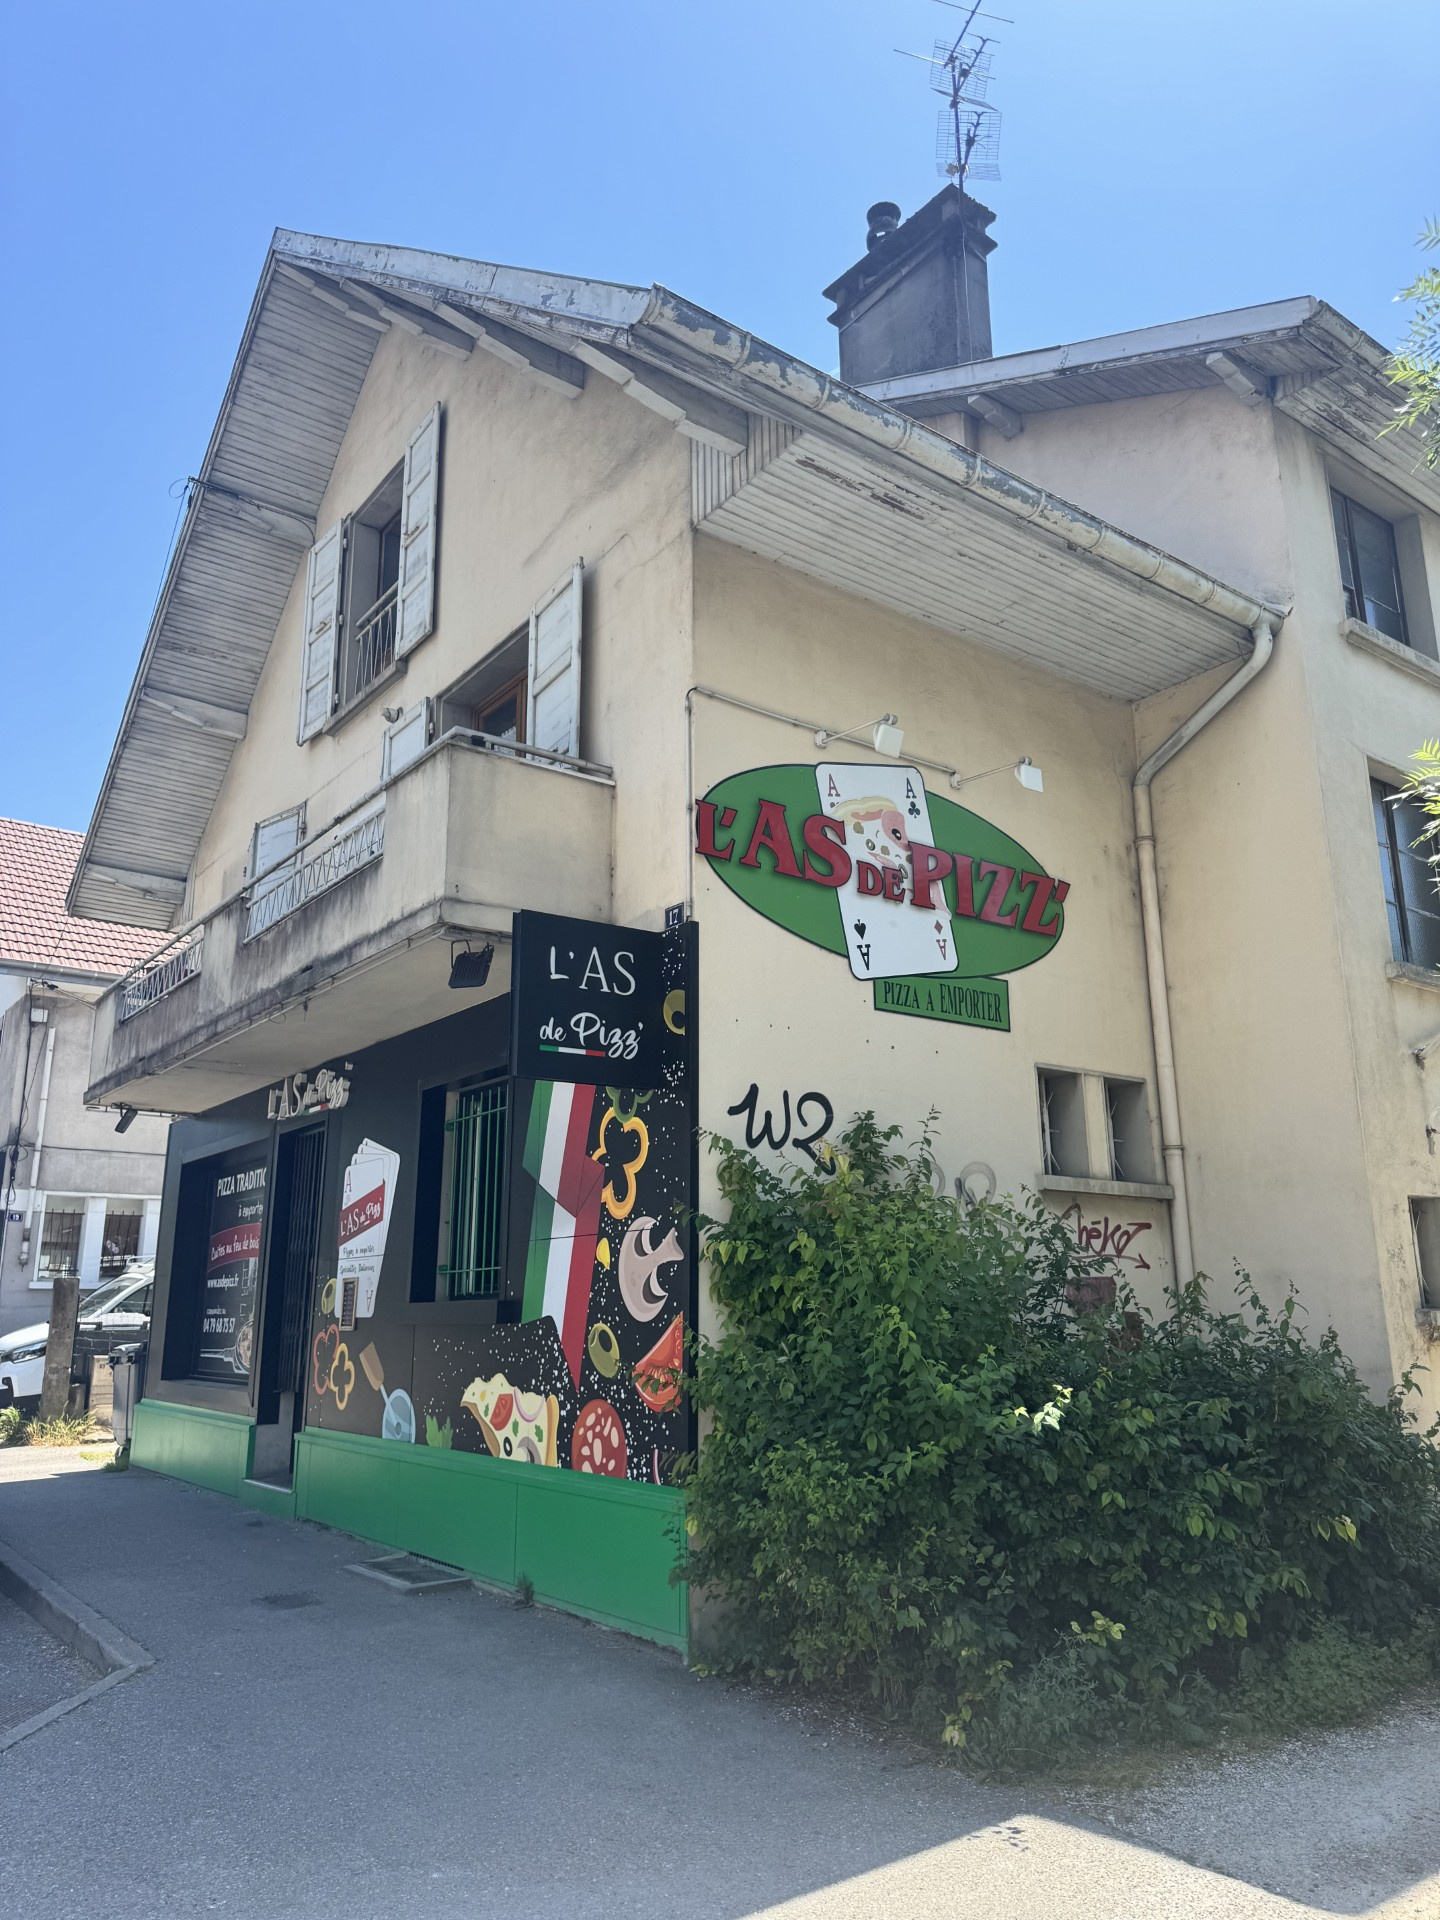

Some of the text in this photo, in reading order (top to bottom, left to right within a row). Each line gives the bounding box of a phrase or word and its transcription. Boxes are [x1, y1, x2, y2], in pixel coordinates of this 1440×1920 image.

[905, 777, 917, 799] A
[695, 799, 1072, 937] L'AS DE PIZZ'
[668, 909, 680, 926] 17
[549, 946, 637, 996] L'AS
[883, 980, 1002, 1023] PIZZA A EMPORTER
[539, 1012, 644, 1060] de Pizz'
[267, 1073, 307, 1120] L'AS
[216, 1175, 235, 1198] PIZZA
